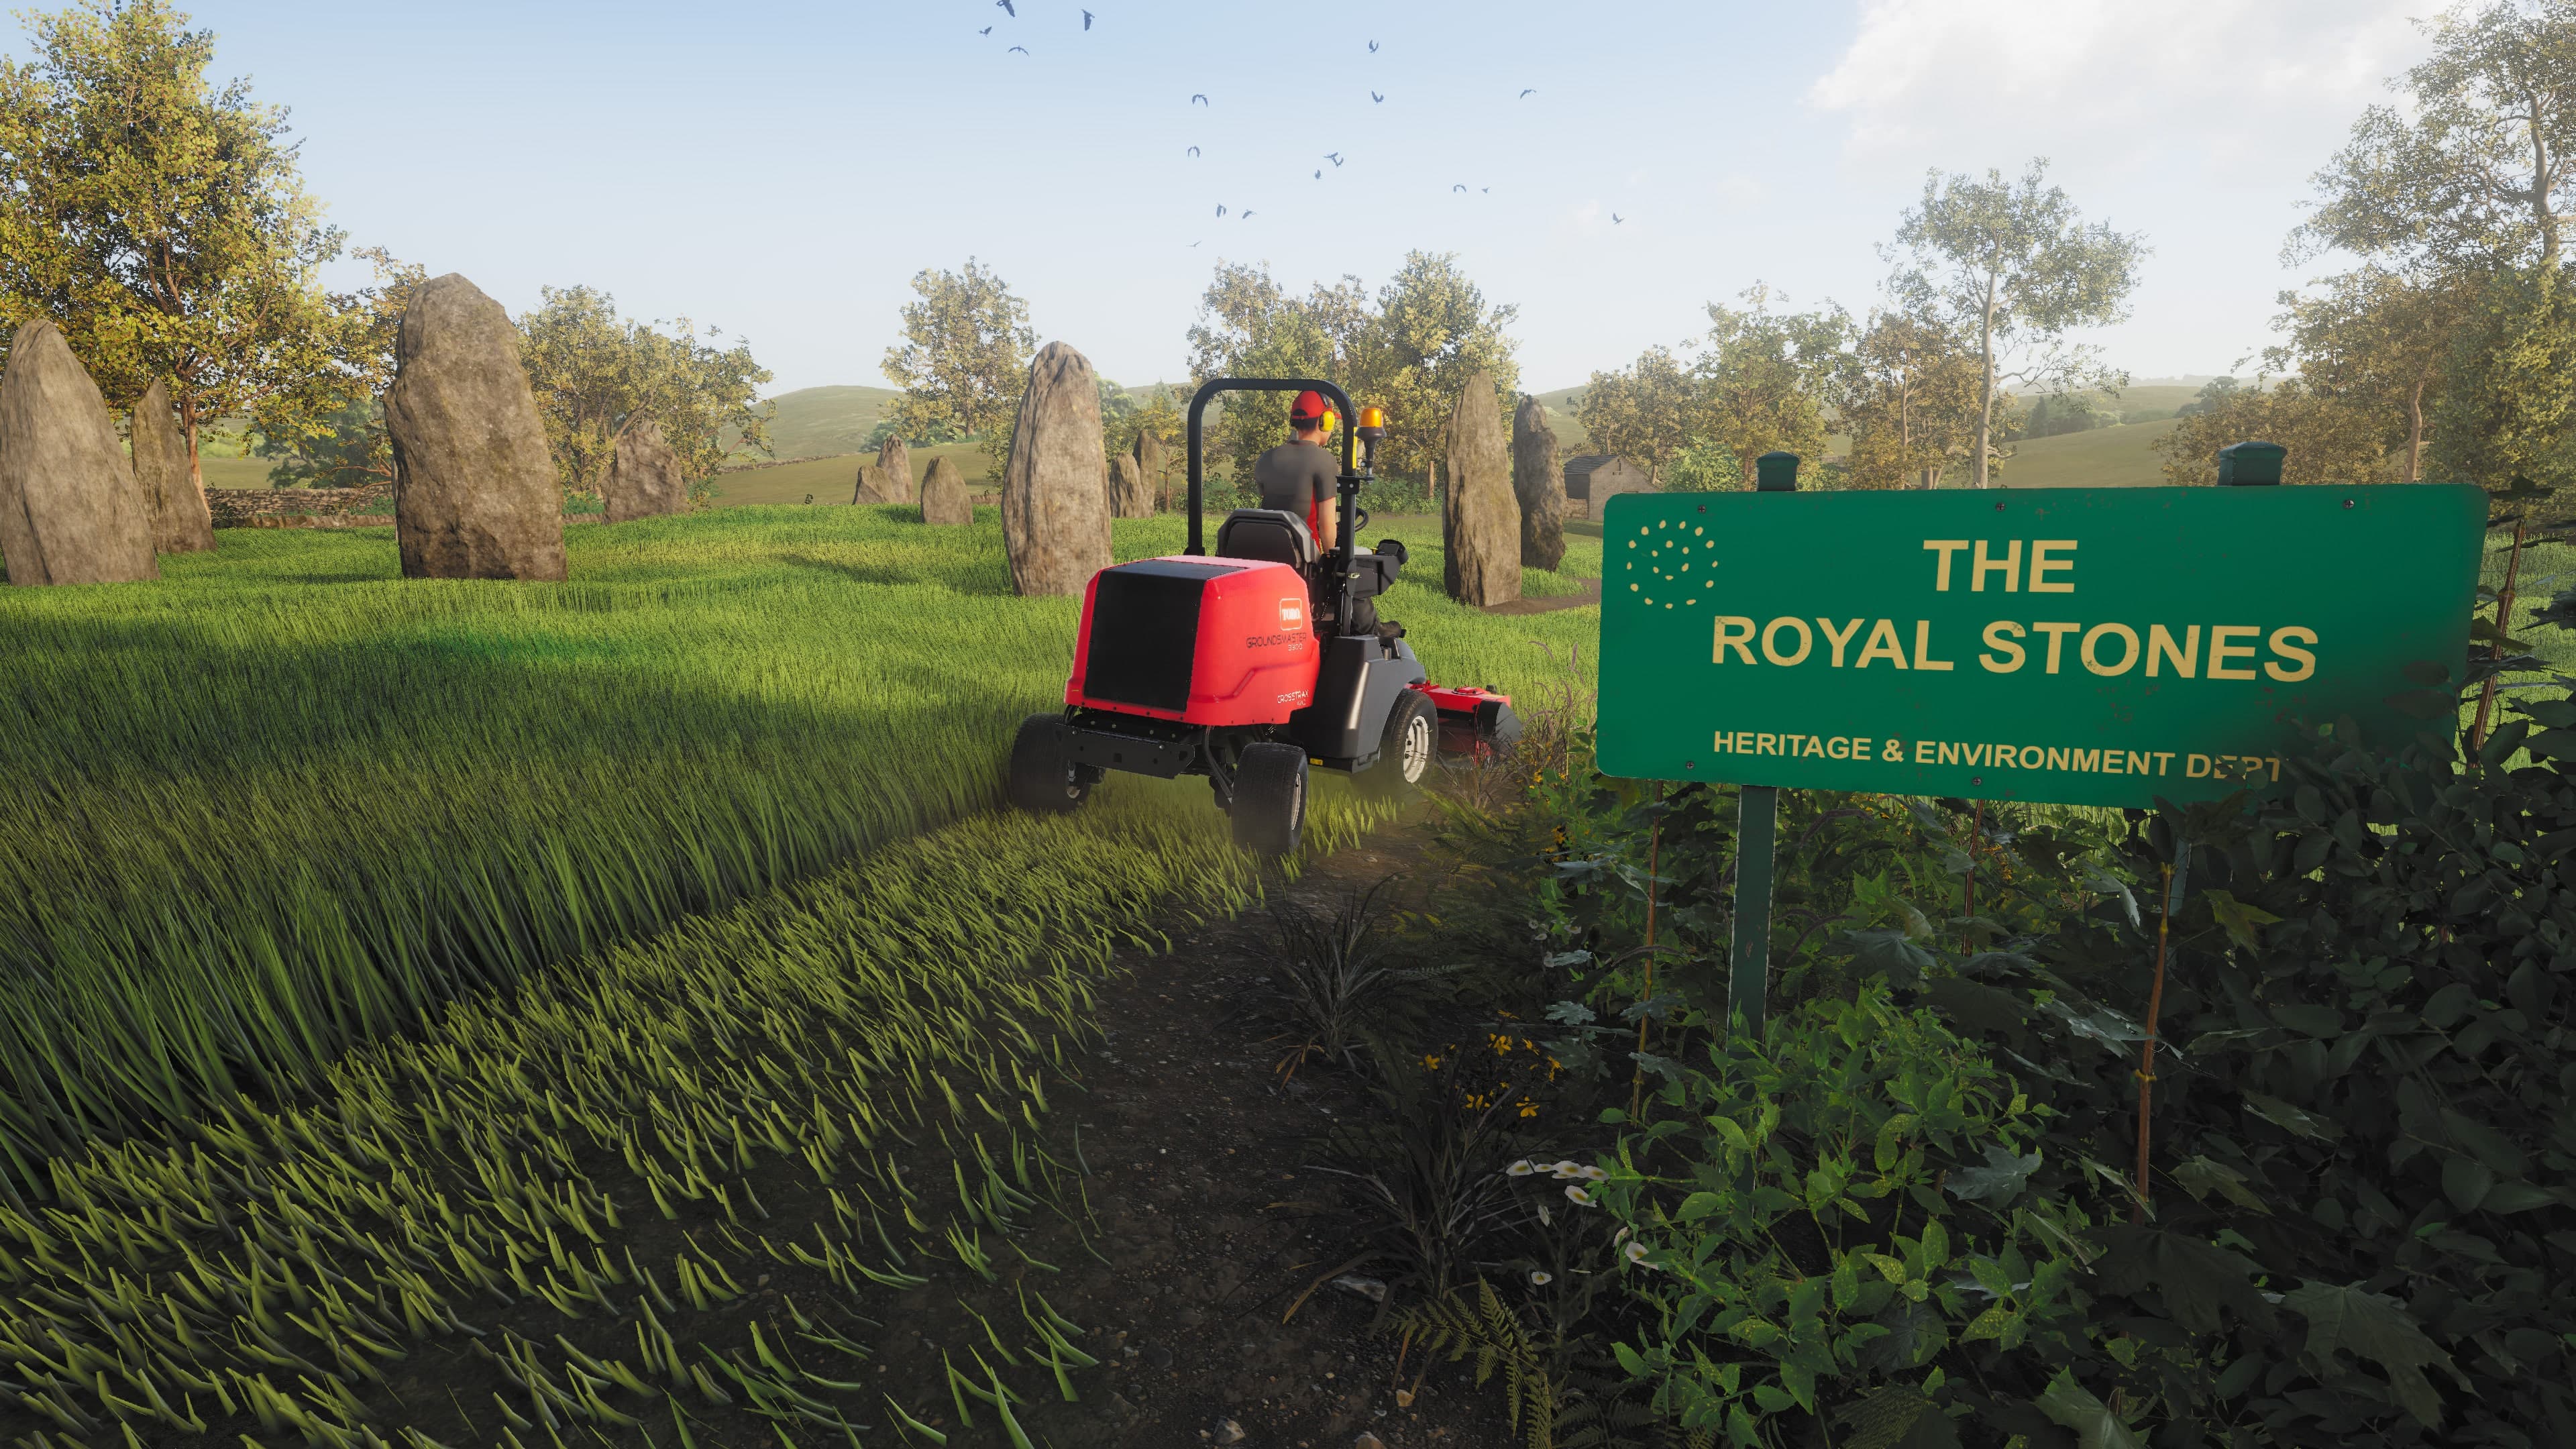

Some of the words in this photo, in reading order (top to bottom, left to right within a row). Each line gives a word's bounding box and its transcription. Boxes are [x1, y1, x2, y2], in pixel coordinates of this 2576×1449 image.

[1923, 539, 2078, 593] THE
[1246, 633, 1307, 648] GROUNDSMASTER
[1711, 615, 1955, 672] ROYAL
[1978, 620, 2319, 683] STONES
[1277, 689, 1309, 704] CROSSTRAX
[1713, 730, 1872, 761] HERITAGE
[1881, 738, 1904, 763] &
[1915, 740, 2176, 777] ENVIRONMENT
